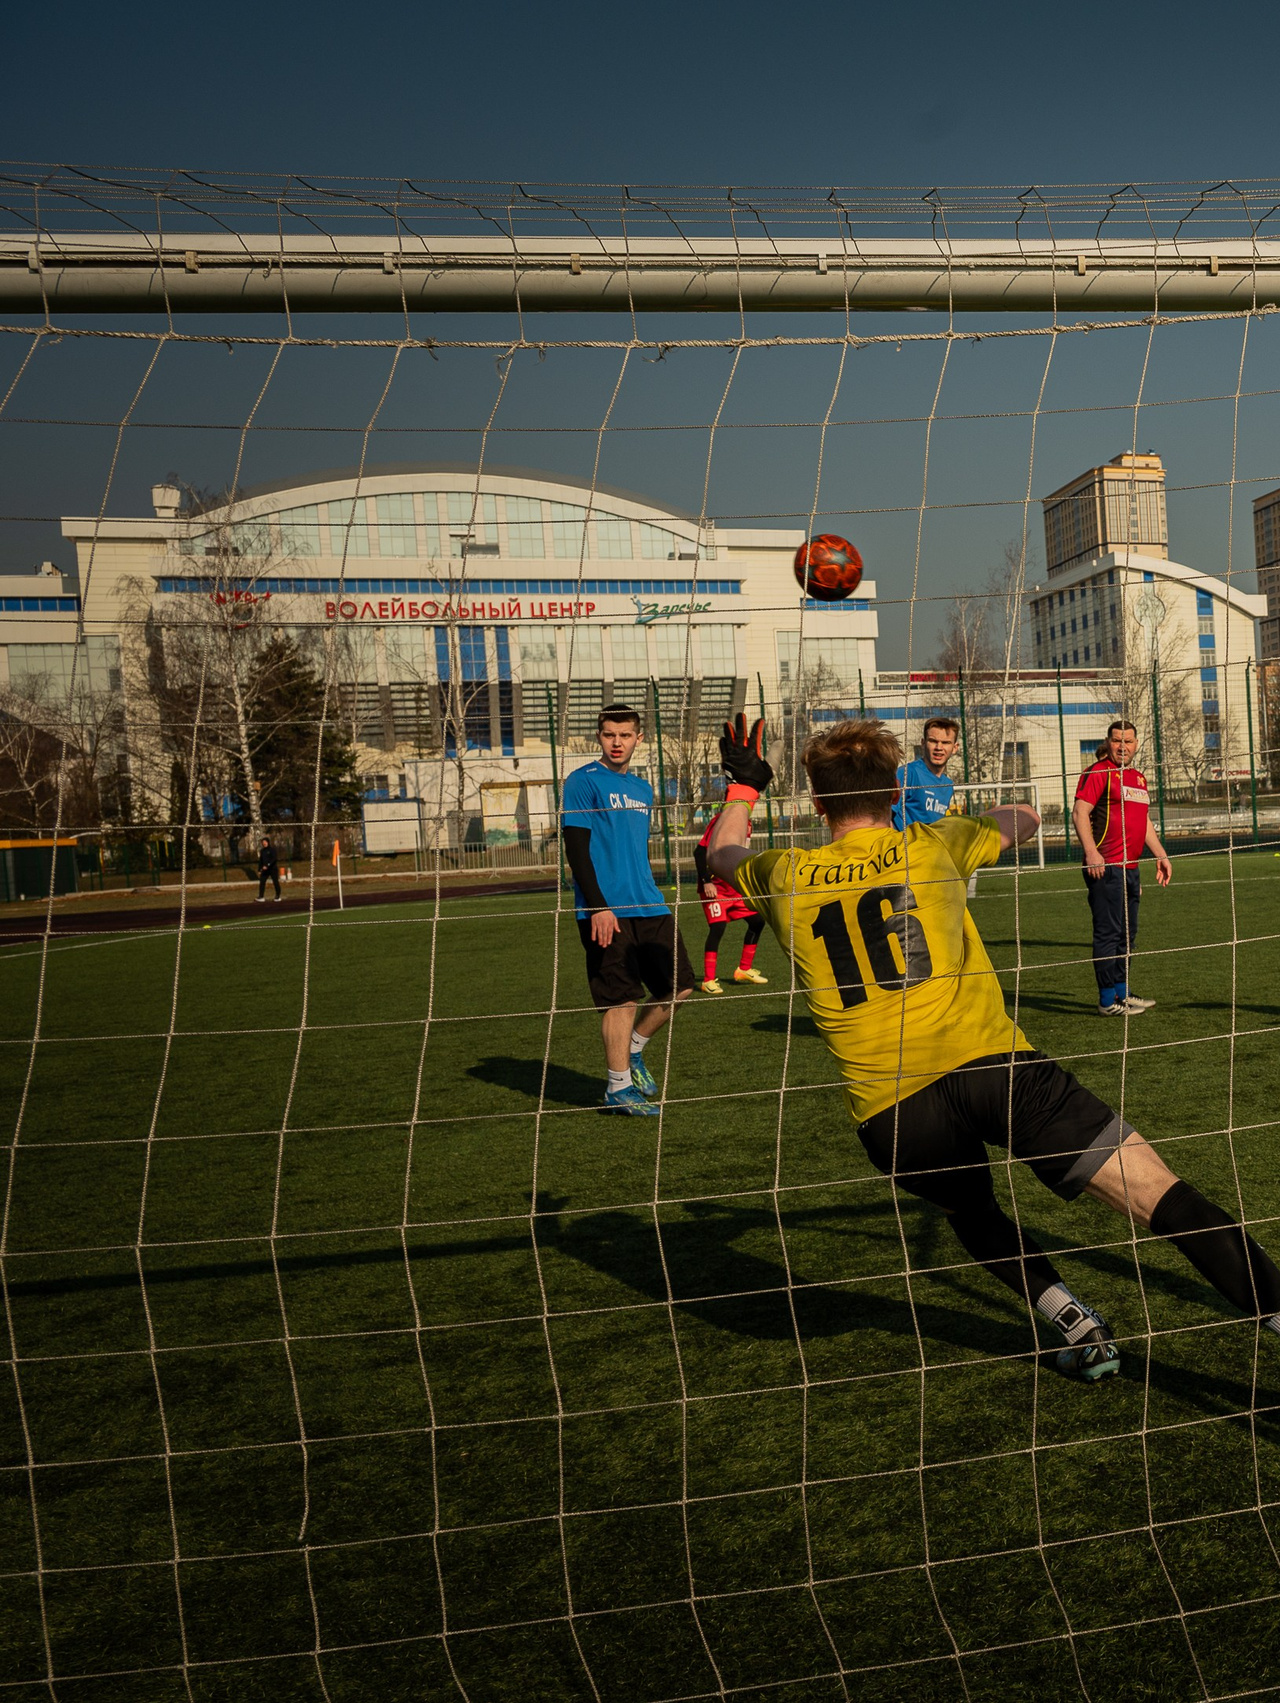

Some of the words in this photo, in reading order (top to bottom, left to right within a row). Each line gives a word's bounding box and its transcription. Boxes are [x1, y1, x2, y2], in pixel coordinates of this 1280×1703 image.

[326, 597, 522, 619] ВОЛЕЙБОЛЬНЫЙ
[531, 602, 596, 620] ЦЕНТР
[609, 793, 623, 809] СК
[708, 902, 722, 918] 19
[811, 883, 933, 1010] 16
